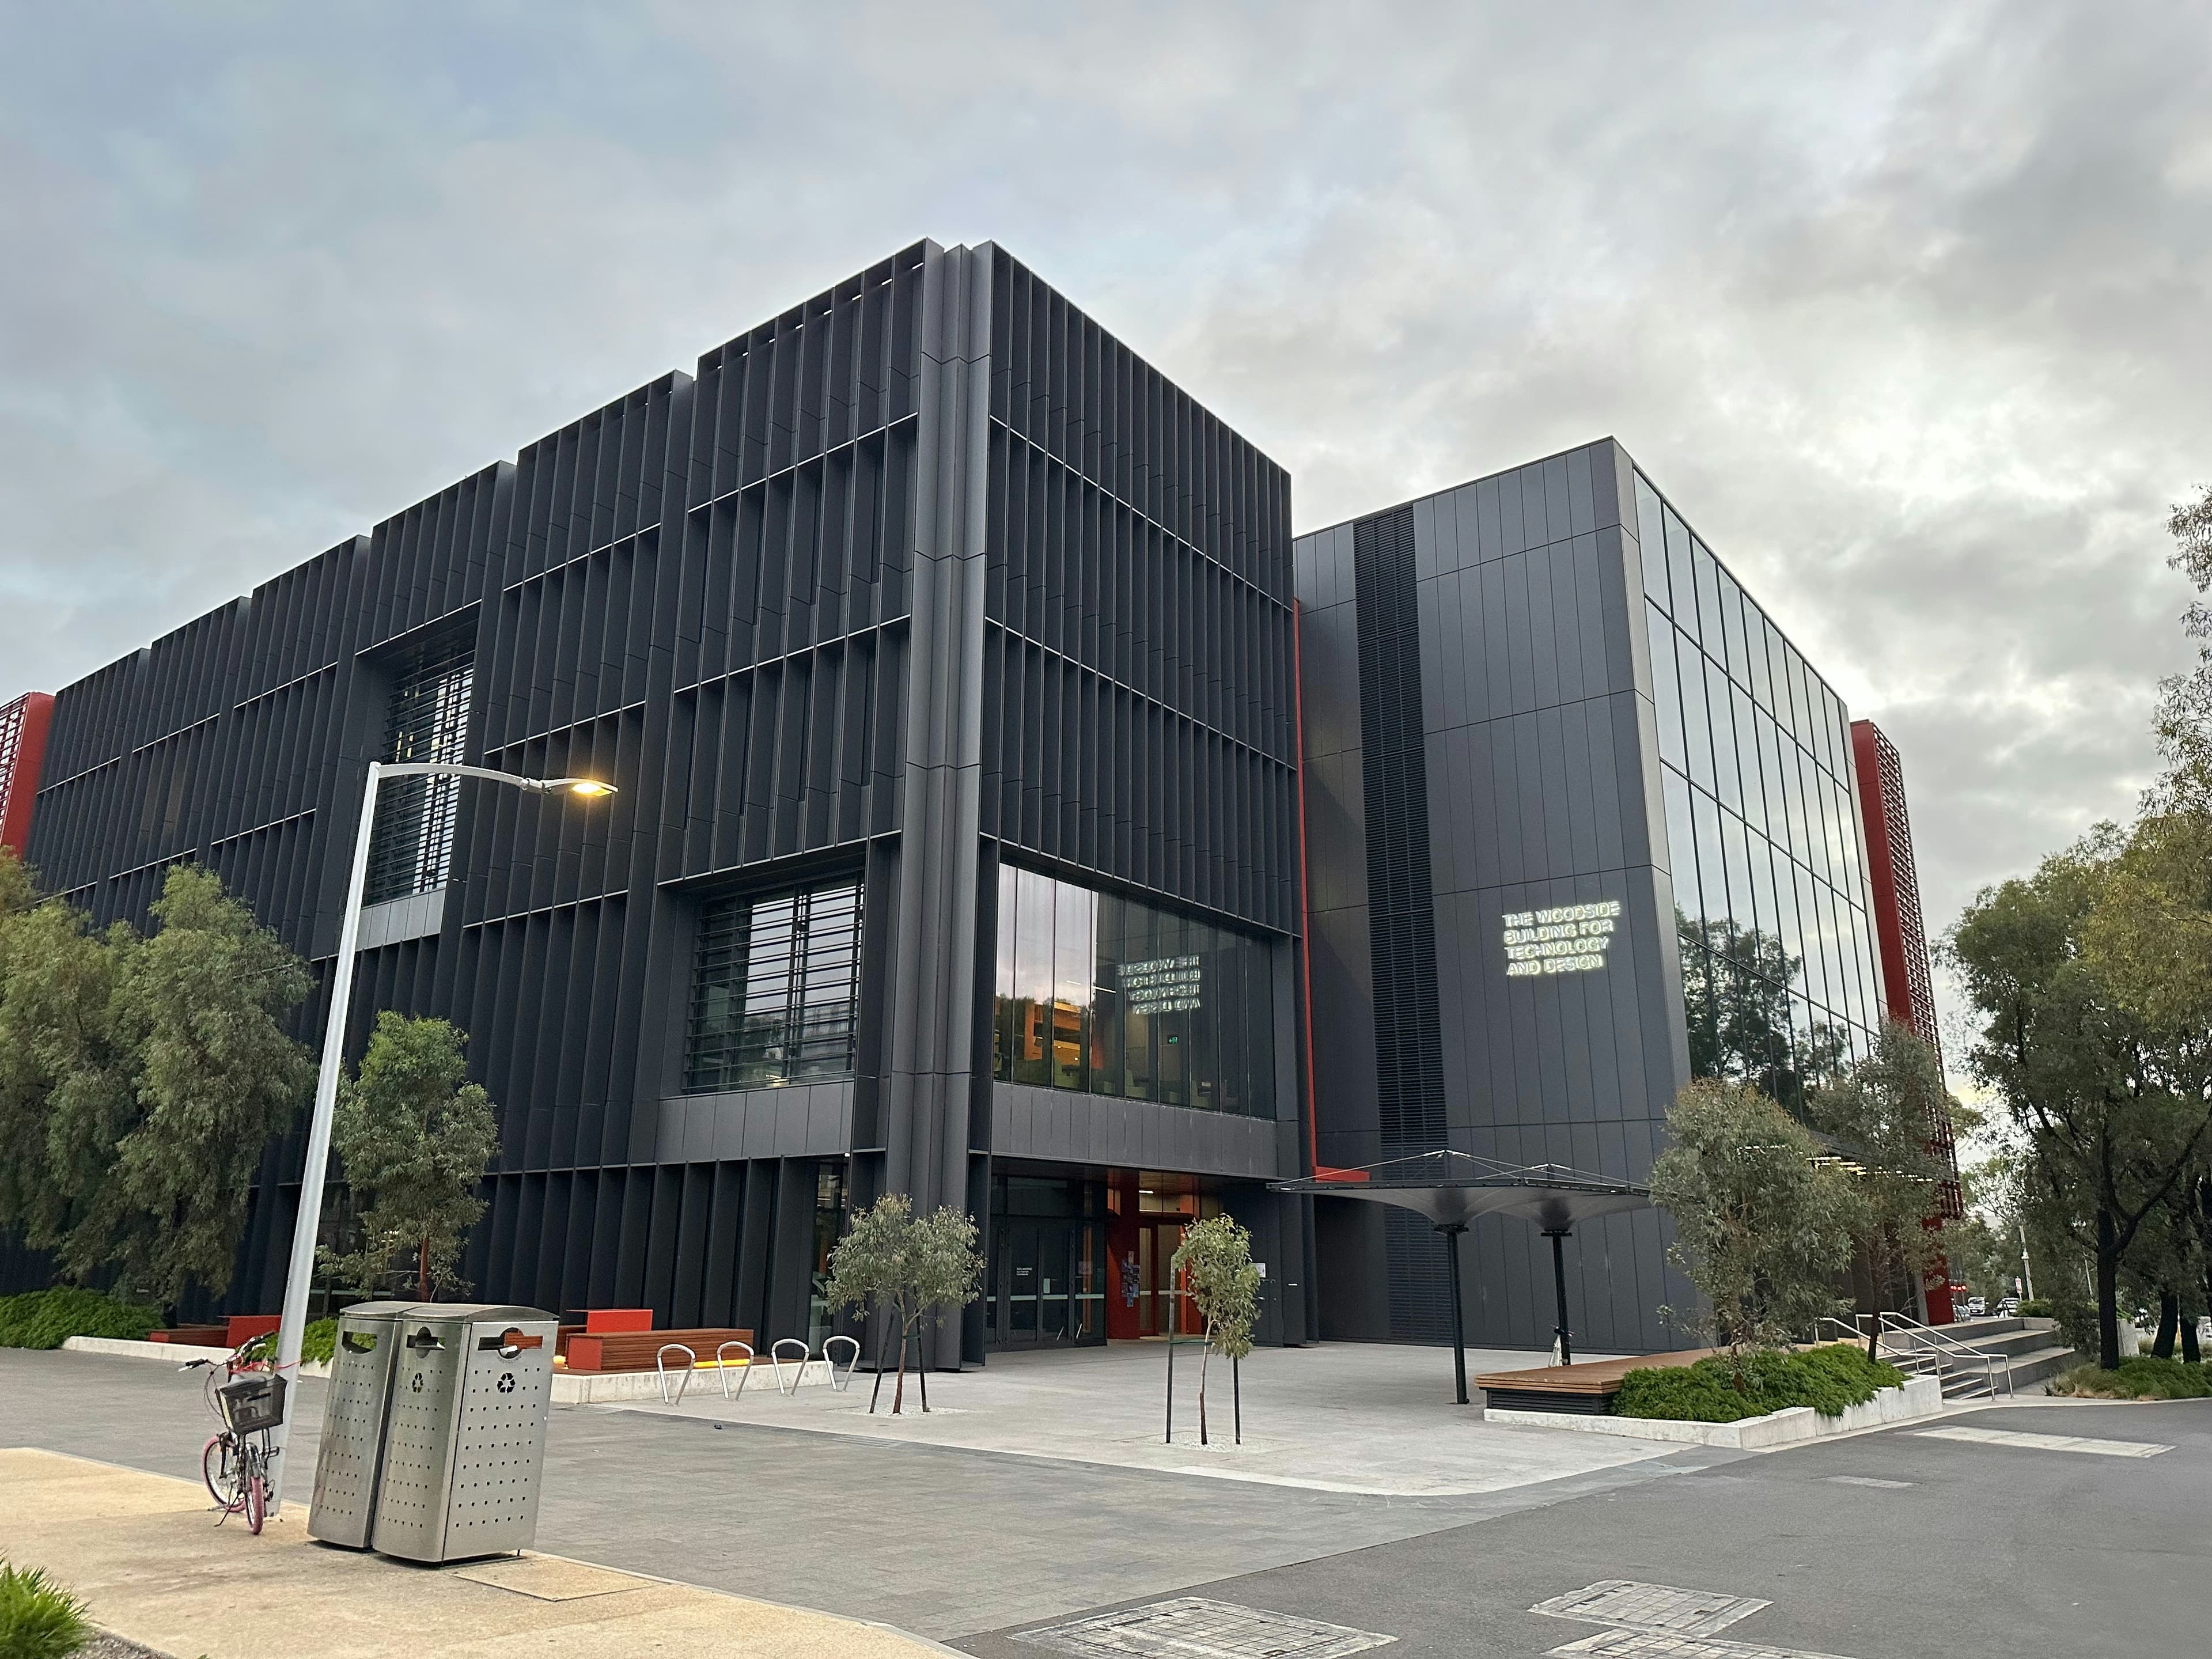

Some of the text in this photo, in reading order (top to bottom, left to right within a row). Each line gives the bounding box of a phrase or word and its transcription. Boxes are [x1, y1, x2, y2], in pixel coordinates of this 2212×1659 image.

[1502, 901, 1620, 927] THE WOODSIDE
[1503, 919, 1613, 945] BUILDING FOR
[1504, 936, 1609, 959] TECHNOLOGY
[1506, 954, 1603, 976] AND DESIGN
